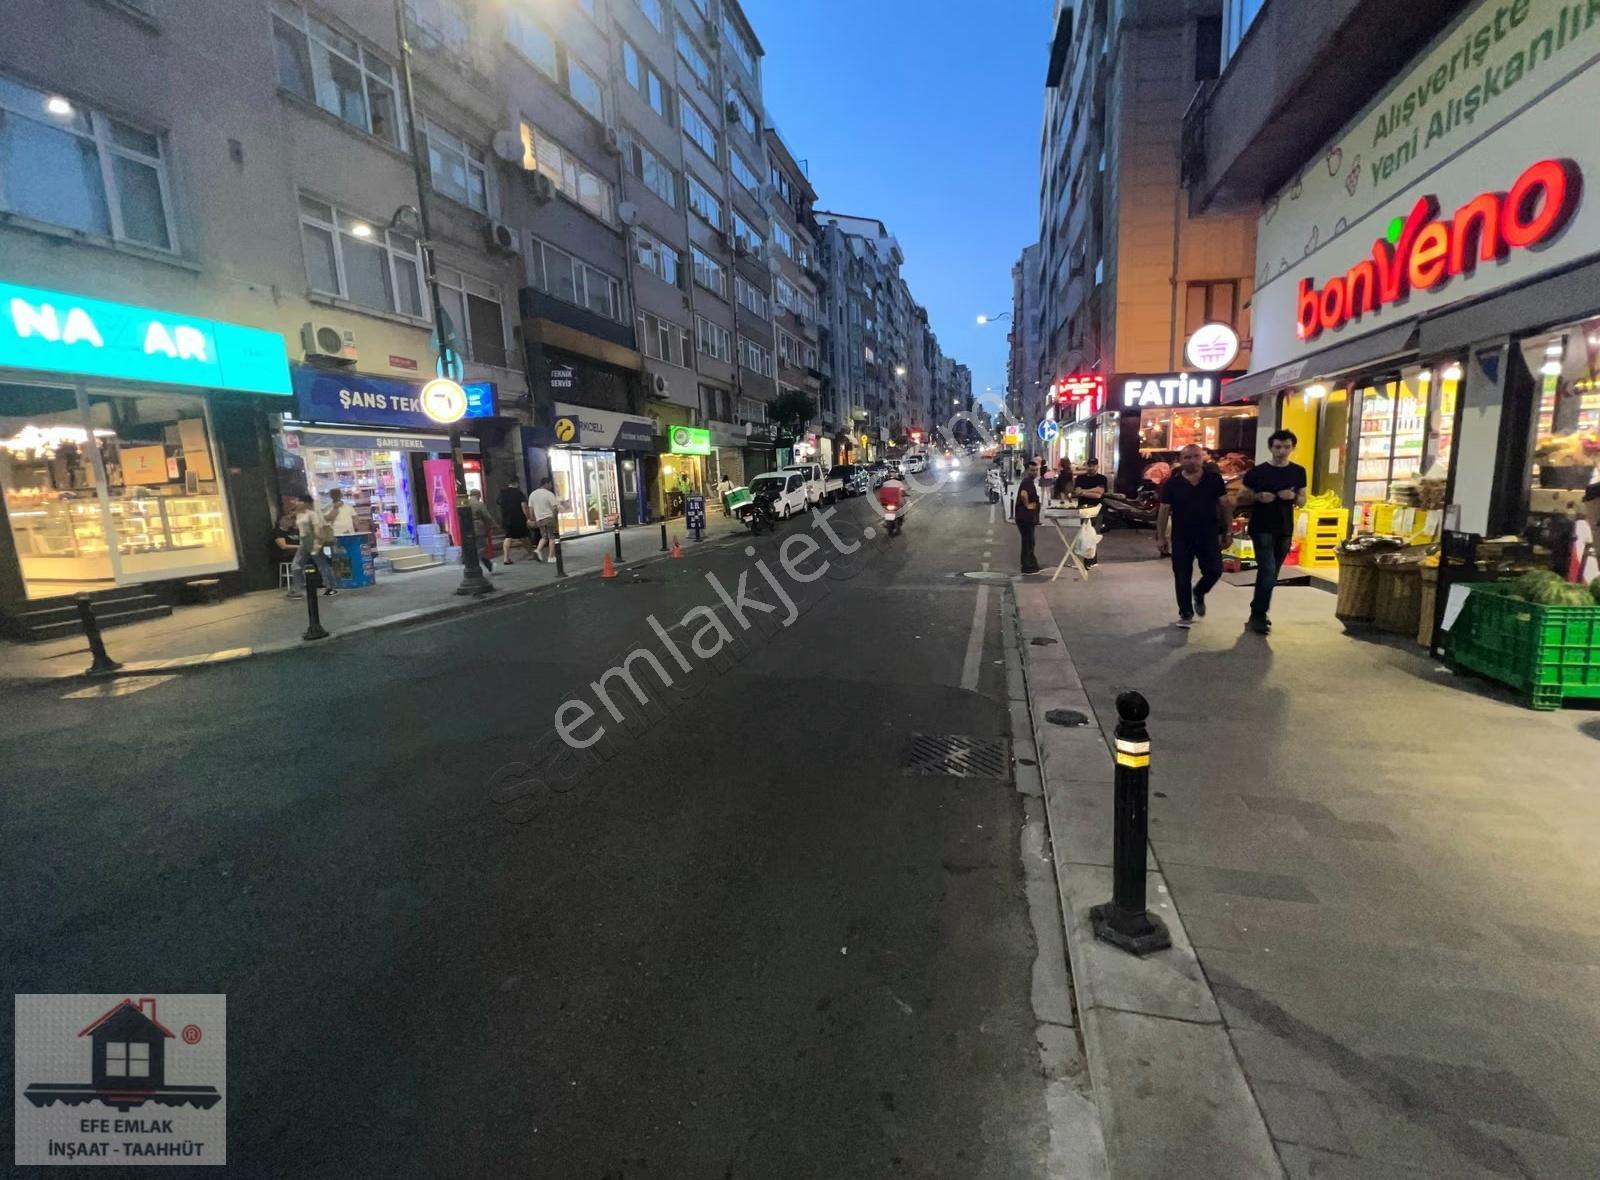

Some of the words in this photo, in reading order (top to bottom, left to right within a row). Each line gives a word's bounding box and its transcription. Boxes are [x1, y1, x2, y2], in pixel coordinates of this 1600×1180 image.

[1371, 127, 1419, 188] Yeni
[339, 389, 387, 410] ŞANS
[1123, 372, 1212, 407] FATİH
